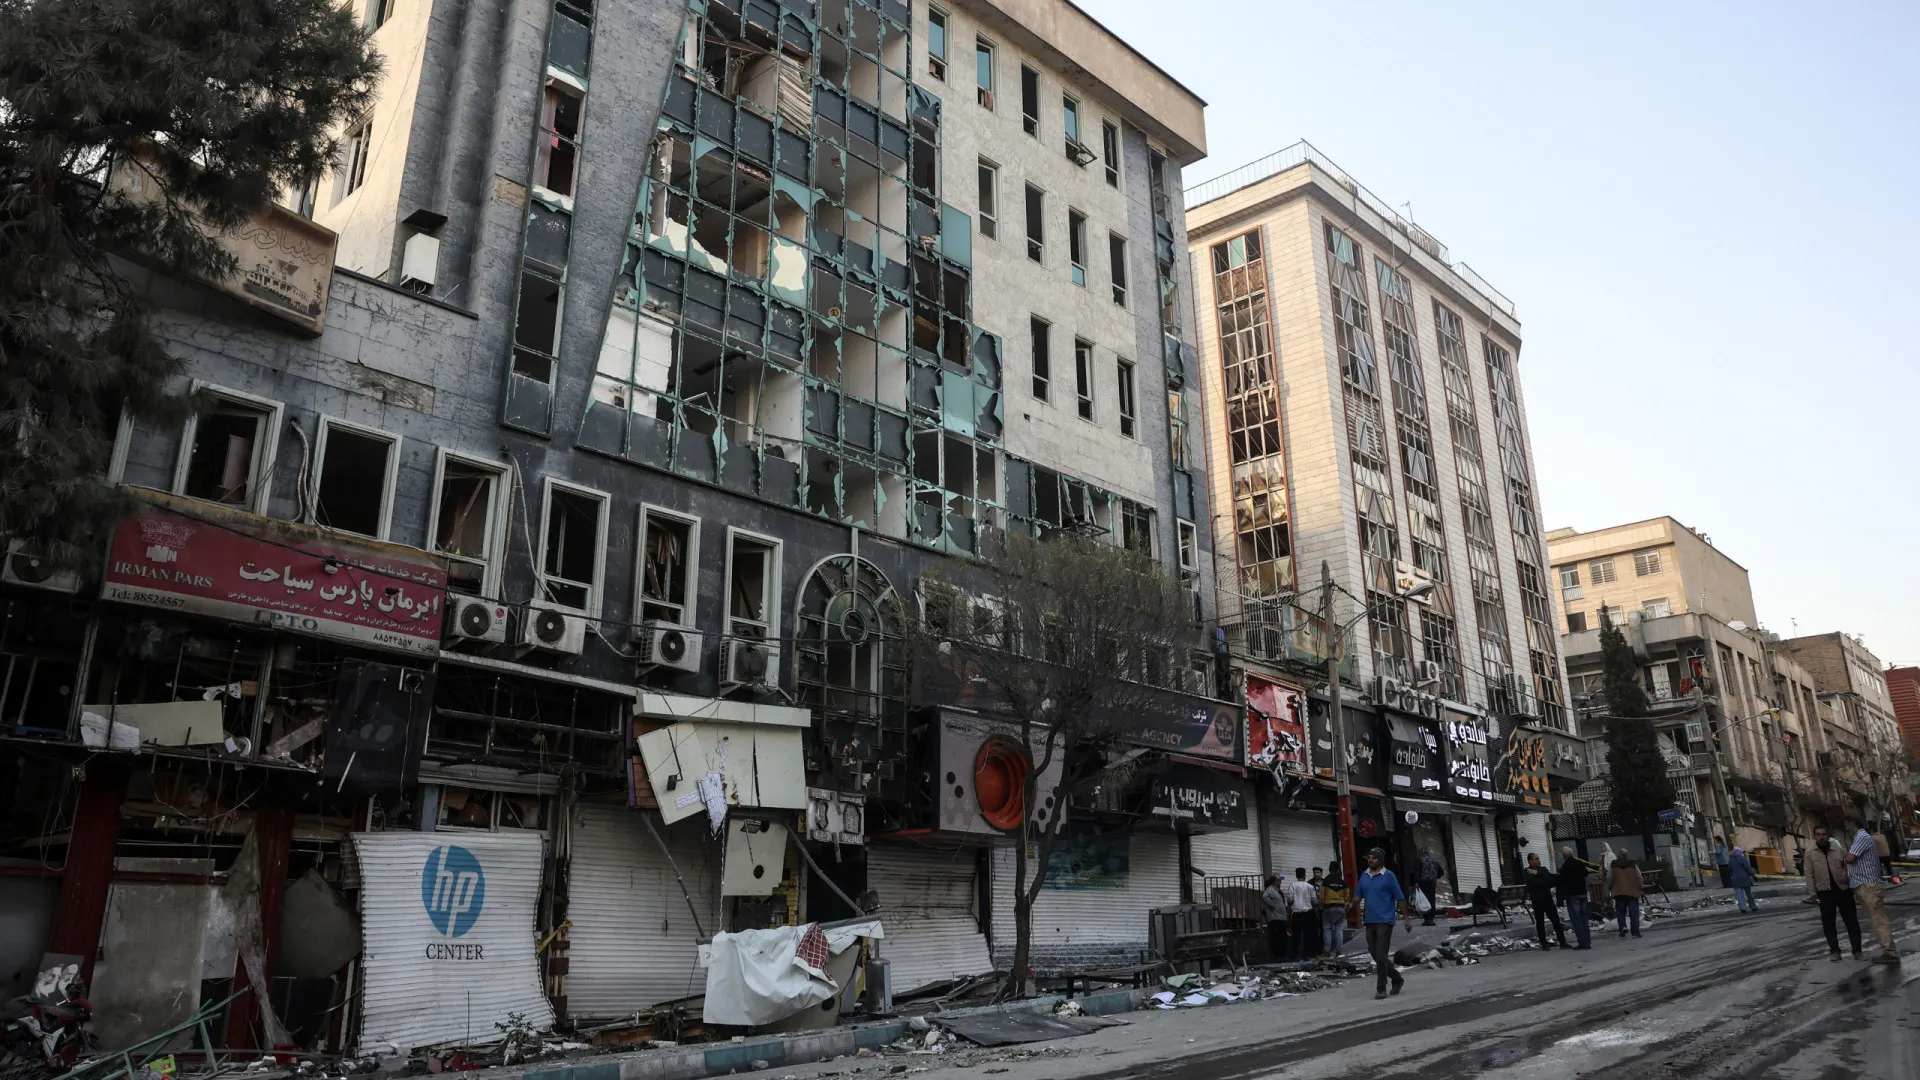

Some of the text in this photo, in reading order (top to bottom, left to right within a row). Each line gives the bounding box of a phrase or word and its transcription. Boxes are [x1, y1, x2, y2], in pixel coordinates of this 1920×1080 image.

[113, 561, 213, 588] IRMAN PARS
[238, 561, 314, 594] سیاحت
[378, 564, 410, 577] خدمات
[412, 572, 438, 584] شرکت
[111, 588, 186, 608] Tel: 88524557
[228, 592, 247, 600] خارجی
[320, 577, 374, 612] پارس
[374, 634, 412, 647] ۸۸۵۲۴۵۵۷
[1141, 728, 1182, 746] AGENCY
[1218, 730, 1232, 740] IATA
[1396, 745, 1426, 770] خانواده
[430, 845, 478, 938] hp
[426, 943, 484, 960] CENTER
